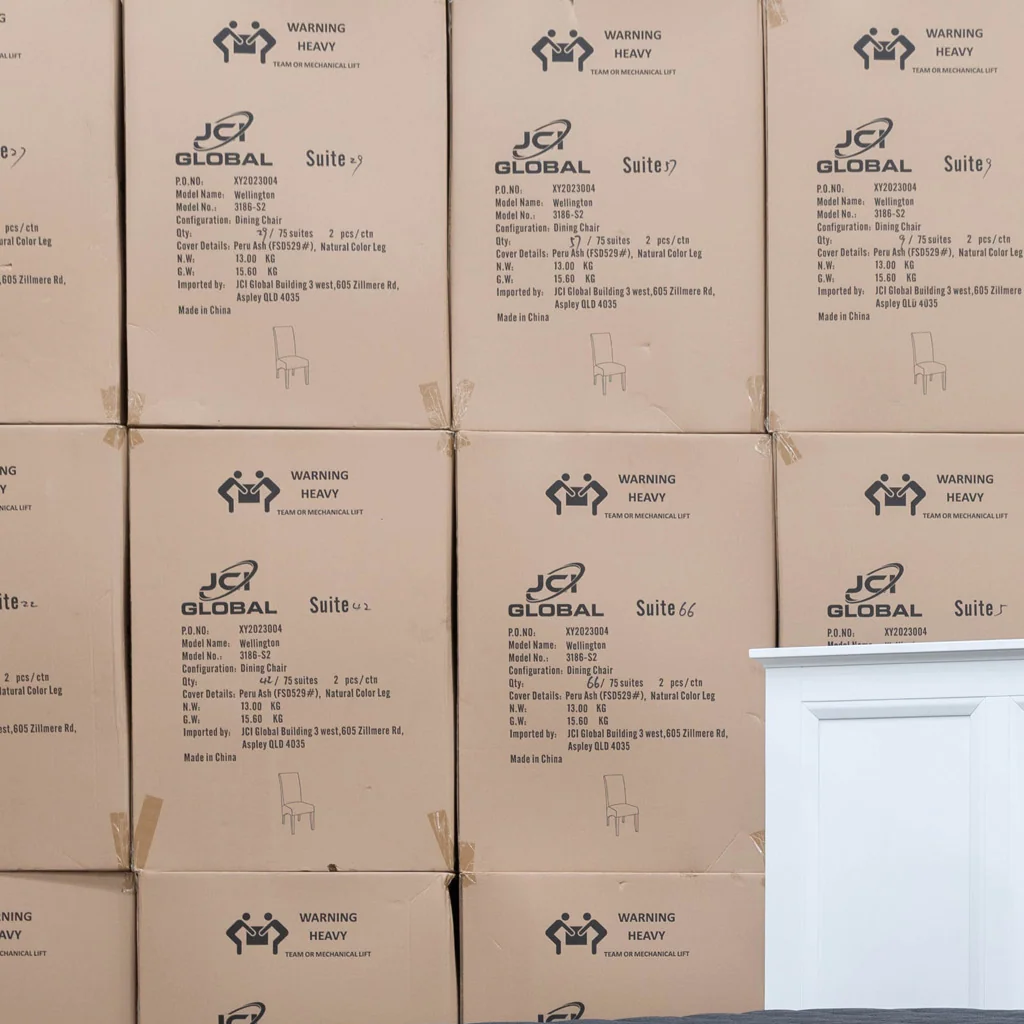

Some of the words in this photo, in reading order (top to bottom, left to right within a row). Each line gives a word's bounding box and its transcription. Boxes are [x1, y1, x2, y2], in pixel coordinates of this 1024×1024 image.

[287, 22, 345, 33] WARNING
[604, 30, 662, 40] WARNING
[926, 28, 983, 38] WARNING
[297, 41, 335, 51] HEAVY
[936, 46, 974, 56] HEAVY
[614, 48, 652, 58] HEAVY
[175, 152, 273, 167] GLOBAL
[306, 150, 345, 167] Suite
[944, 155, 983, 172] Suite
[495, 161, 590, 174] GLOBAL
[623, 157, 661, 173] Suite
[816, 160, 912, 173] GLOBAL
[234, 176, 278, 185] XY2023004
[176, 190, 198, 198] Model
[234, 191, 275, 201] Wellington
[176, 203, 198, 211] Model
[234, 203, 266, 212] 3186-S2
[235, 216, 260, 226] Dining
[261, 216, 282, 225] Chair
[646, 235, 650, 244] 2
[819, 312, 838, 321] Made
[841, 312, 847, 320] in
[850, 312, 871, 320] China
[290, 470, 349, 481] WARNING
[618, 474, 676, 484] WARNING
[936, 474, 994, 484] WARNING
[301, 488, 339, 499] HEAVY
[628, 492, 666, 502] HEAVY
[946, 492, 984, 502] HEAVY
[181, 601, 277, 615] GLOBAL
[310, 597, 349, 614] Suite
[508, 604, 604, 617] GLOBAL
[636, 600, 675, 616] Suite
[679, 602, 696, 617] 66
[955, 600, 993, 617] Suite
[827, 604, 923, 618] GLOBAL
[884, 627, 927, 636] XY2023004
[510, 692, 530, 700] Cover
[566, 692, 582, 700] Peru
[584, 692, 597, 700] Ash
[650, 692, 678, 700] Natural
[680, 691, 700, 700] Color
[702, 691, 715, 701] Leg
[241, 702, 262, 710] 13.00
[271, 702, 280, 710] KG
[241, 715, 262, 723] 15.60
[273, 715, 283, 723] KG
[30, 724, 62, 733] Zillmere
[510, 730, 543, 739] Imported
[568, 730, 578, 738] JCI
[581, 729, 604, 738] Global
[607, 729, 637, 739] Building
[639, 729, 643, 737] 3
[683, 729, 714, 738] Zillmere
[568, 742, 592, 752] Aspley
[595, 742, 608, 750] QLD
[611, 742, 630, 750] 4035
[0, 911, 32, 922] NING
[299, 912, 357, 923] WARNING
[618, 912, 676, 923] WARNING
[309, 930, 347, 941] HEAVY
[628, 930, 666, 941] HEAVY
